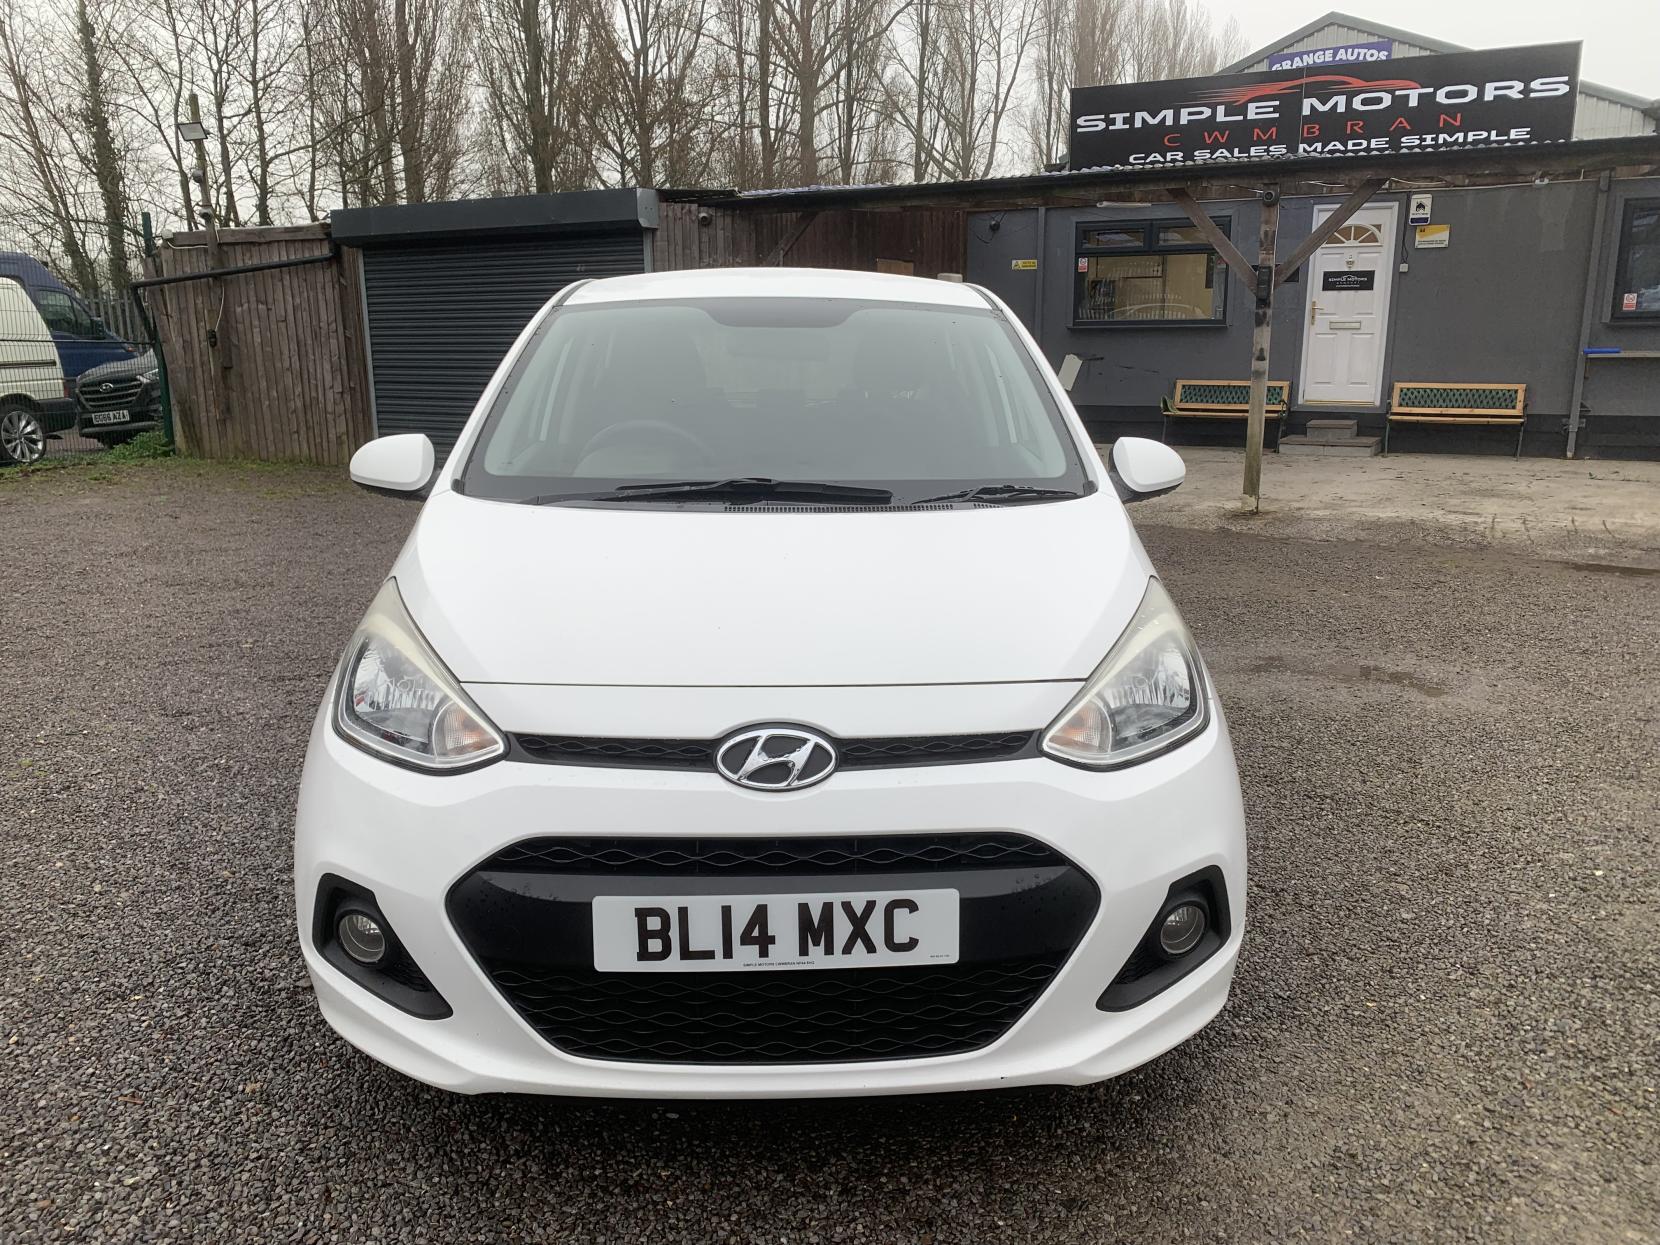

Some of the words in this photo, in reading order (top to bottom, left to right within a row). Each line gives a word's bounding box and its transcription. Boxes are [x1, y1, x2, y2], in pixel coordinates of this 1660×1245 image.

[1271, 49, 1333, 71] GRANGE
[1334, 48, 1389, 62] AUTOS
[1076, 100, 1280, 133] SIMPLE
[1302, 76, 1570, 116] MOTORS
[1129, 151, 1184, 165] CAR
[1193, 144, 1287, 161] SALES
[1298, 137, 1390, 153] MADE
[1400, 127, 1531, 146] SIMPLE
[1163, 113, 1462, 147] CWMBRAN
[634, 903, 776, 962] BL14
[797, 898, 920, 957] MXC
